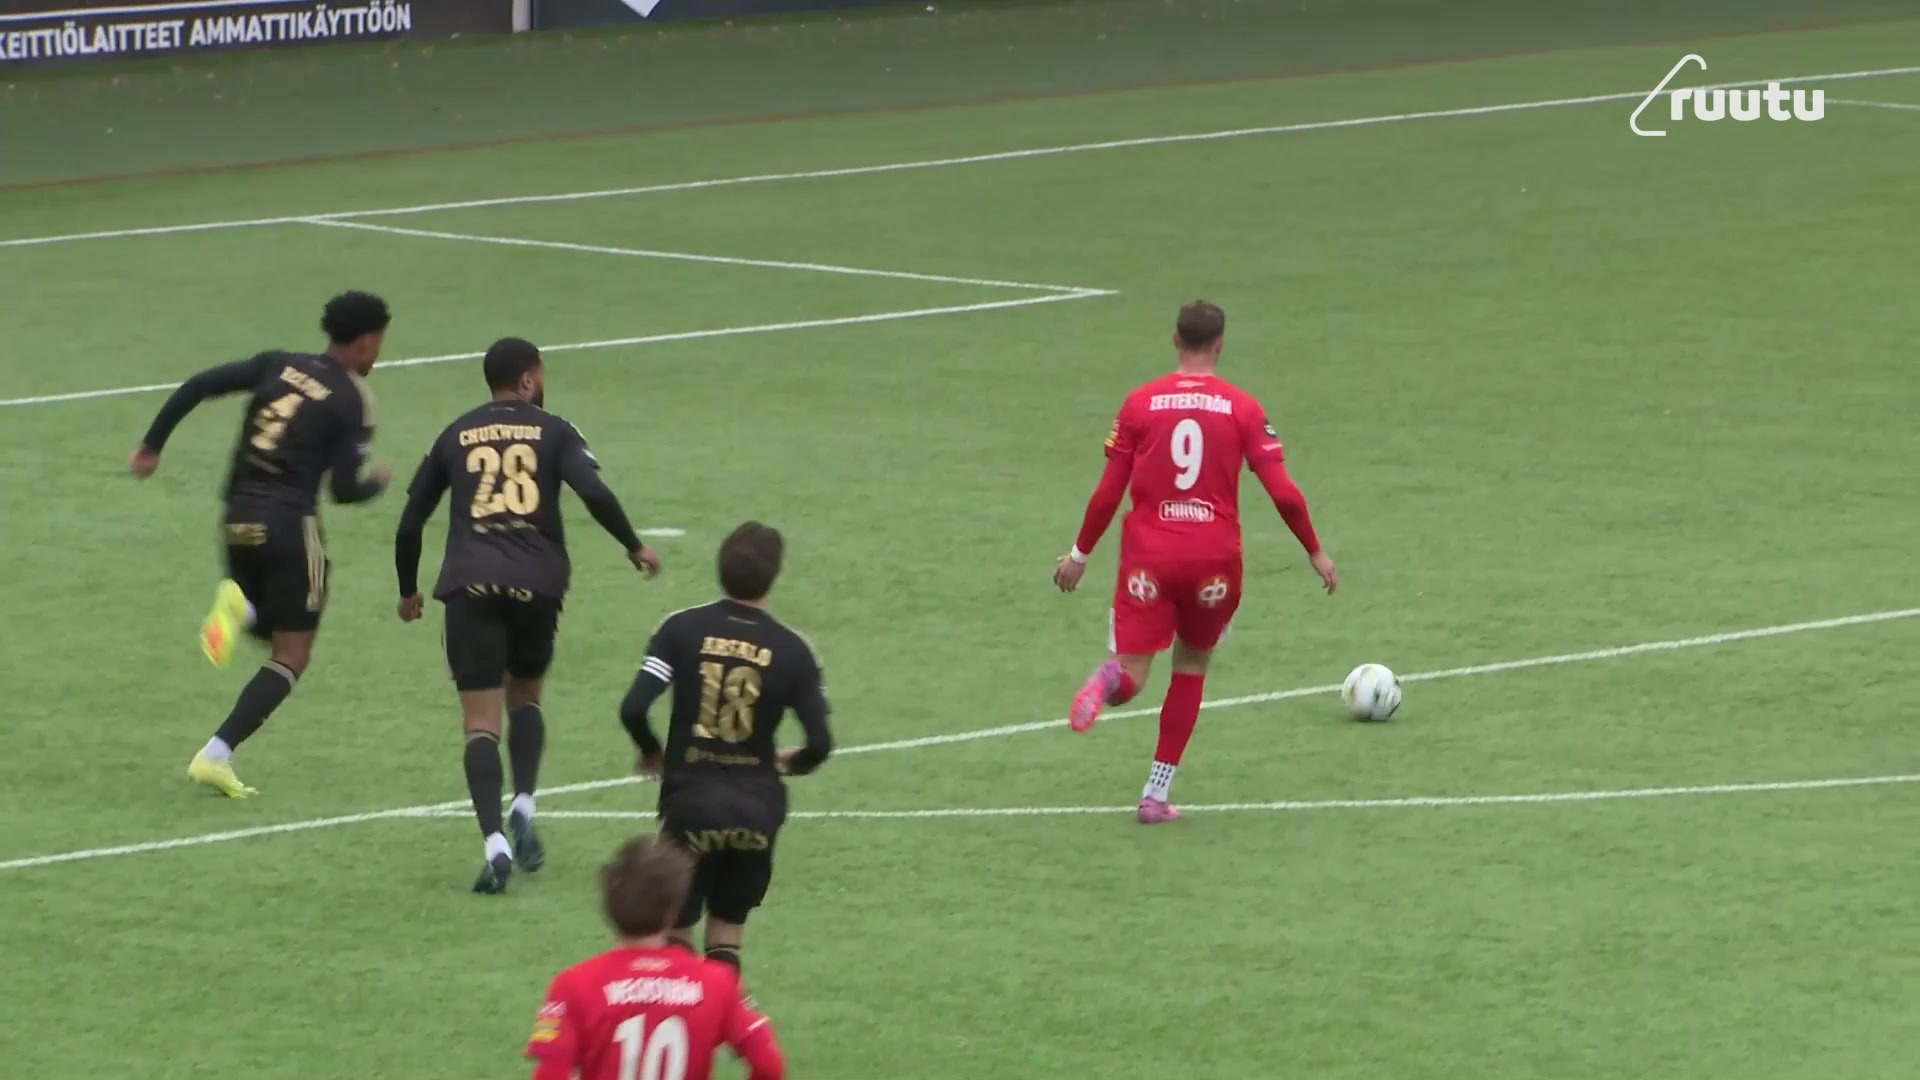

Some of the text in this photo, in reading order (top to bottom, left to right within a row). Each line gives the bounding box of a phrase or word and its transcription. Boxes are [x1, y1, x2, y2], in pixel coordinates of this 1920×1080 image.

[190, 2, 411, 46] AMMATTIKÄYTTÖÖN
[459, 424, 542, 447] CHUKWUDI
[1149, 393, 1233, 415] ZETTERSTRÖM
[466, 443, 540, 518] 28
[1171, 418, 1204, 490] 9
[692, 661, 763, 743] 18
[612, 1013, 690, 1080] 10
